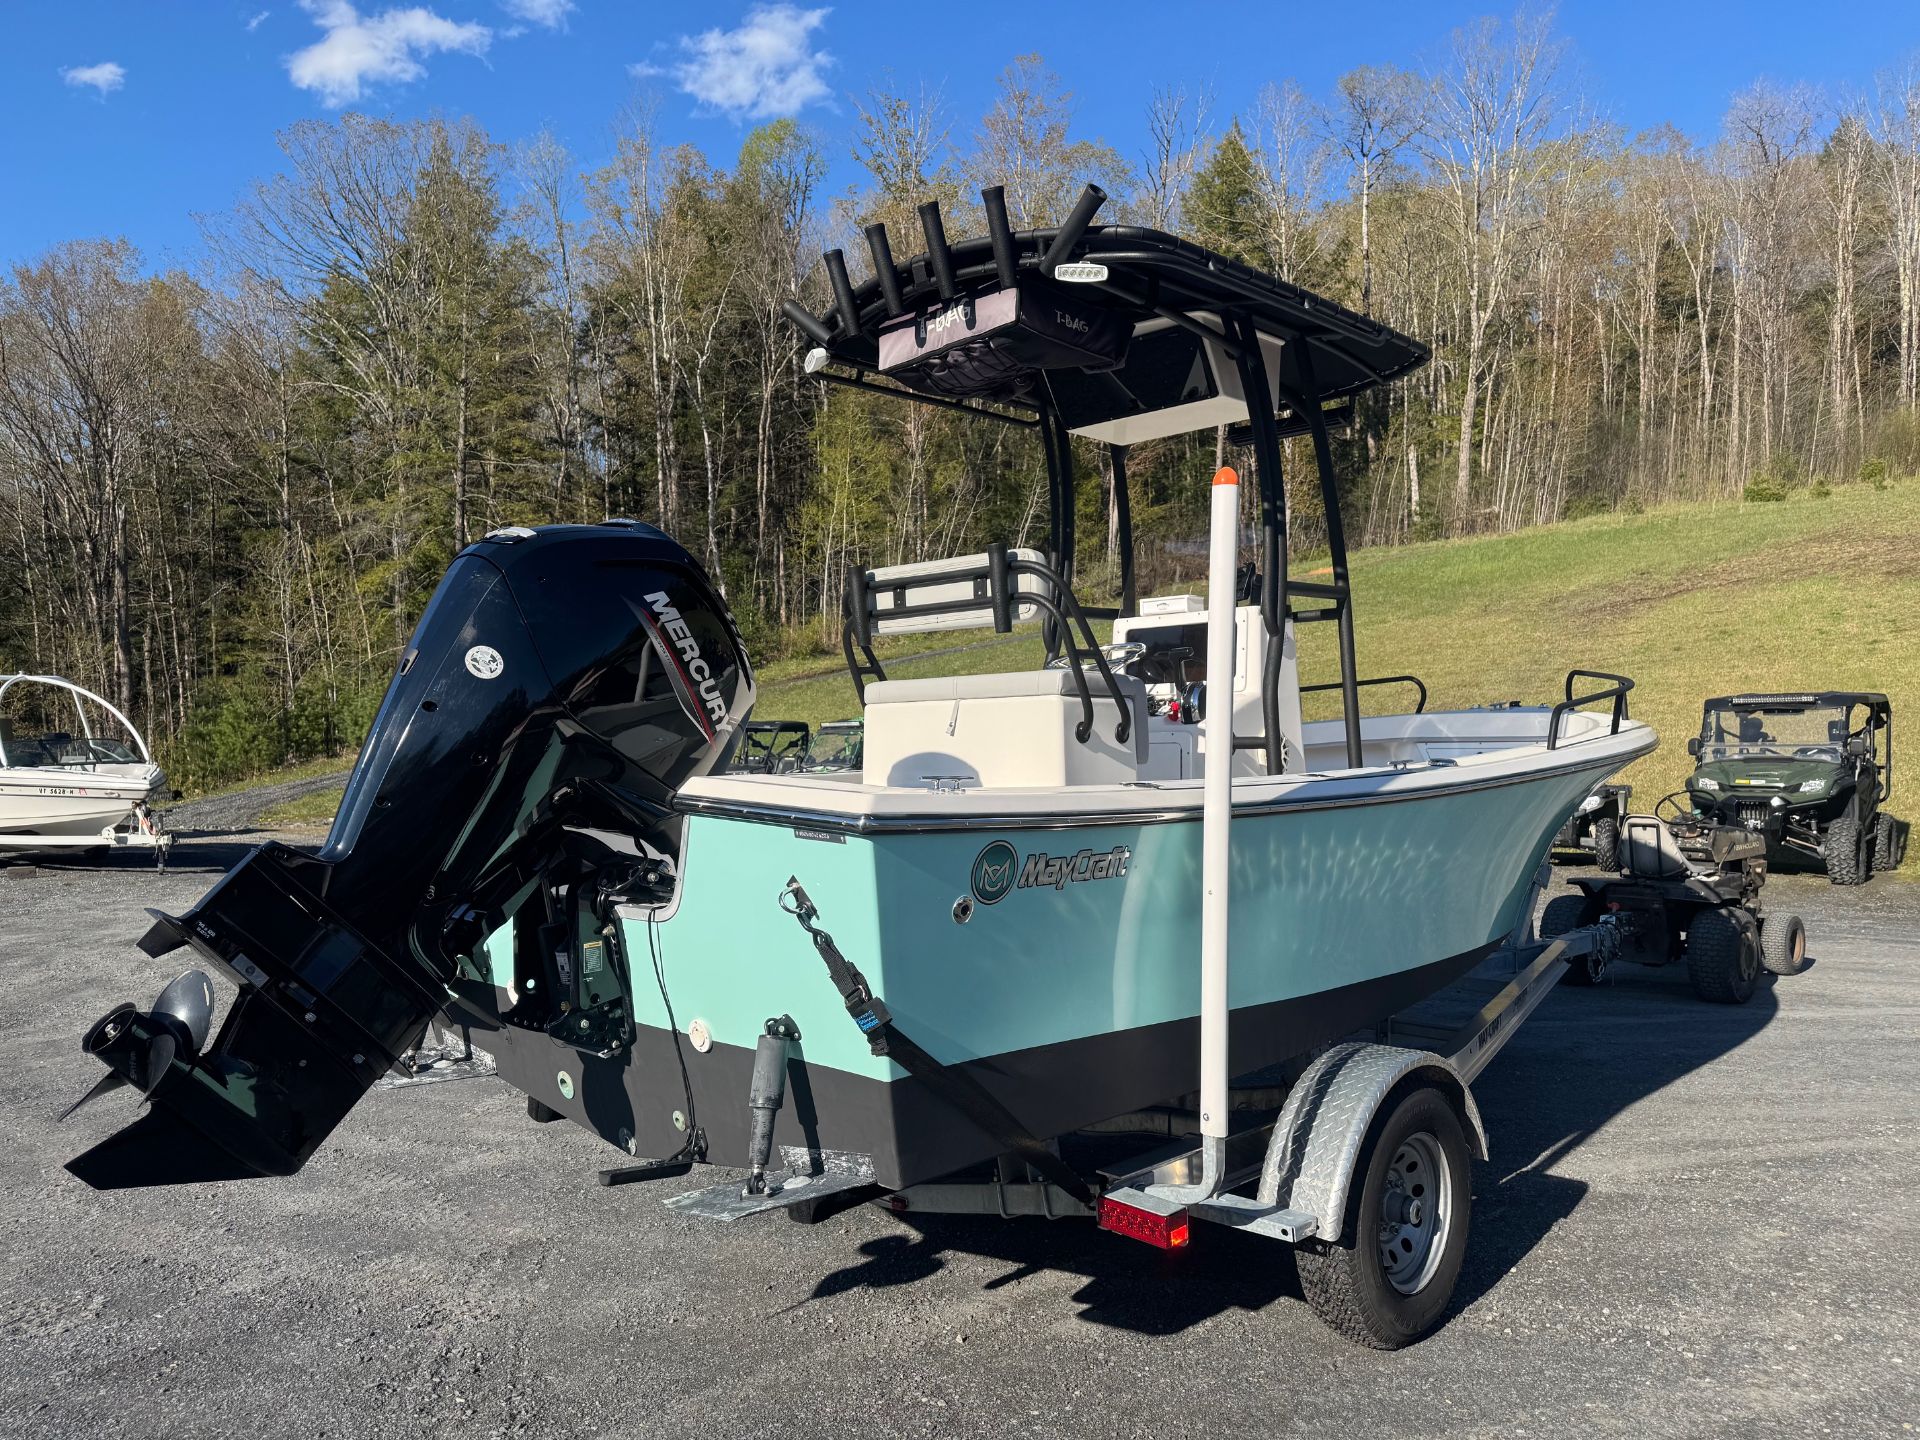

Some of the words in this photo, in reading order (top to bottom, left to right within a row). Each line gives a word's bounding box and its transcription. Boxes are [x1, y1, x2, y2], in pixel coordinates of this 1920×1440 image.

[916, 297, 971, 338] T-BAG
[1054, 309, 1089, 333] T-BAG
[643, 590, 733, 732] MERCURY
[1017, 845, 1132, 890] MayCraft
